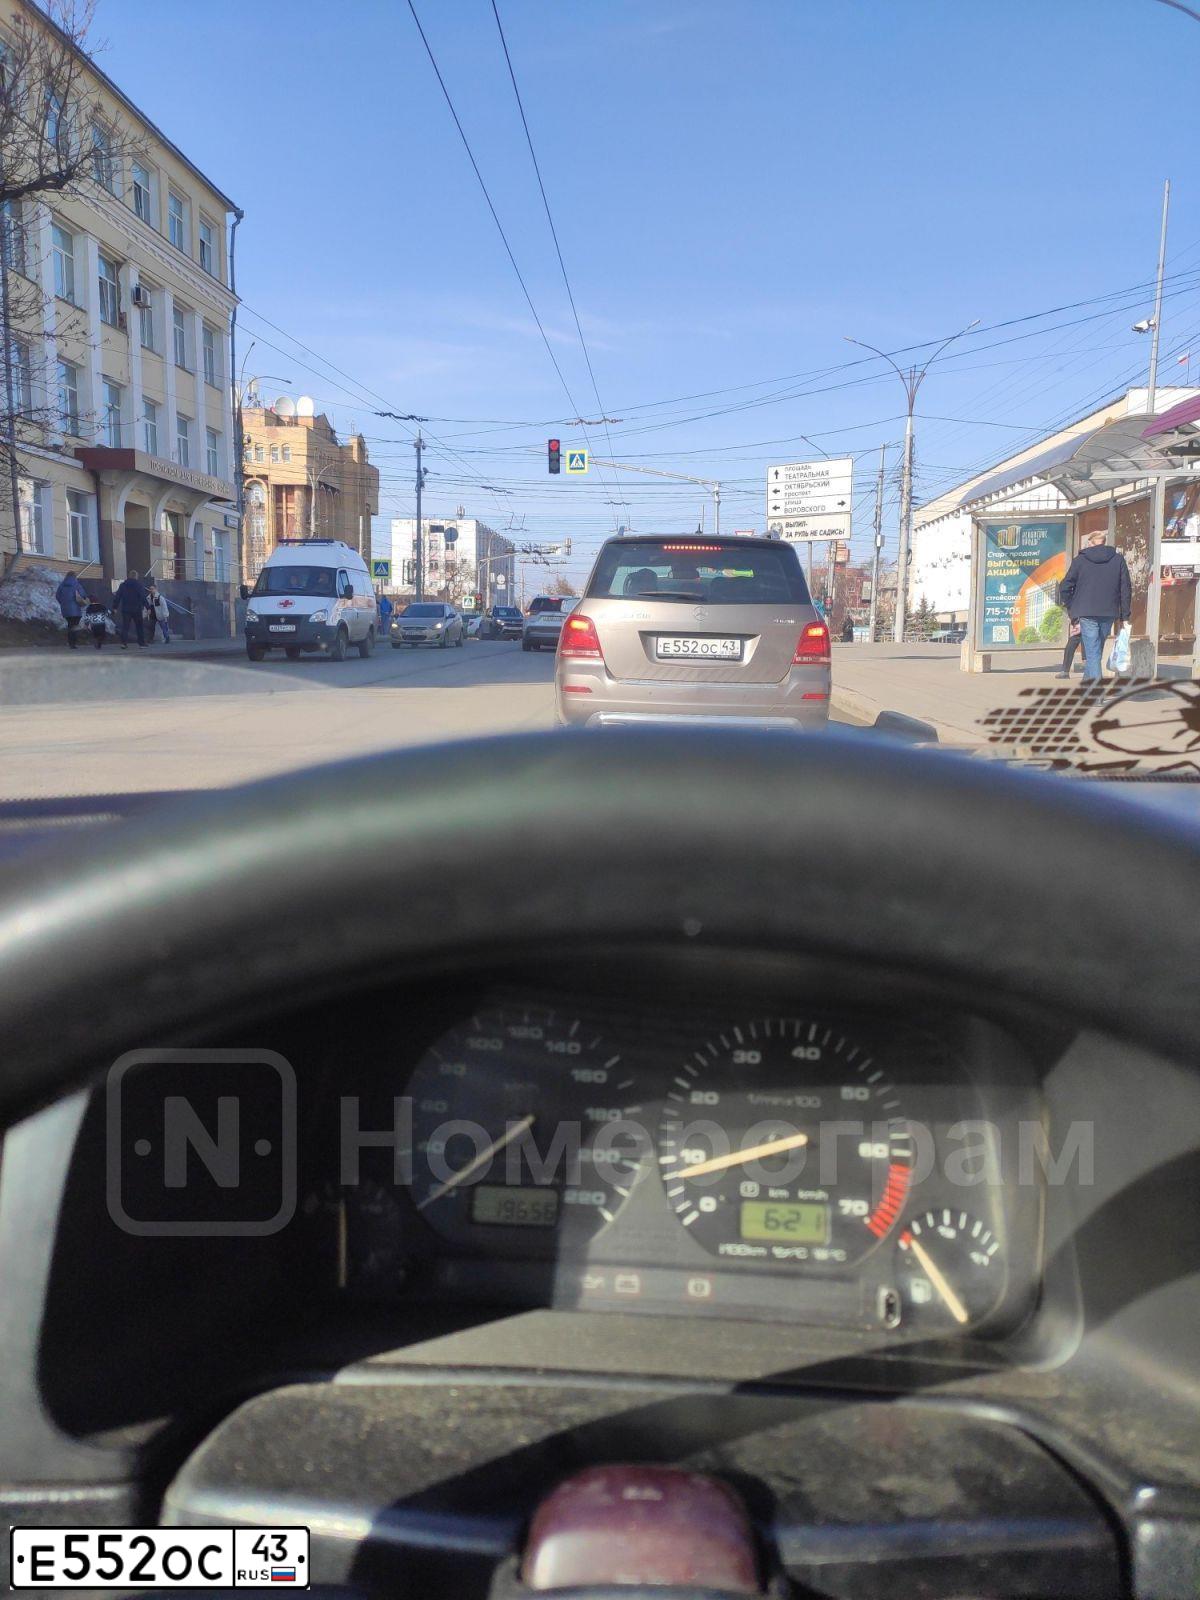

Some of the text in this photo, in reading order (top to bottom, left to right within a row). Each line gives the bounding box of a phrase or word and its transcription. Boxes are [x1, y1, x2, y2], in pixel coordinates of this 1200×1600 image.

[784, 470, 830, 480] ТЕАТРАЛЬНАЯ
[784, 481, 830, 491] ОКТЯБРЬСКИЙ
[784, 505, 826, 514] ВОРОВСКОГО
[794, 530, 809, 538] РУЛЬ
[810, 529, 818, 537] НЕ
[987, 558, 1041, 568] ВЫГОДНЫЕ
[986, 568, 1020, 577] АКЦИИ
[986, 606, 1021, 616] 715-705
[722, 640, 736, 651] 43
[733, 1049, 762, 1065] 30
[791, 1046, 821, 1061] 40
[690, 1090, 720, 1105] 20
[858, 1142, 889, 1158] 60
[699, 1196, 717, 1212] 0
[838, 1198, 869, 1216] 70
